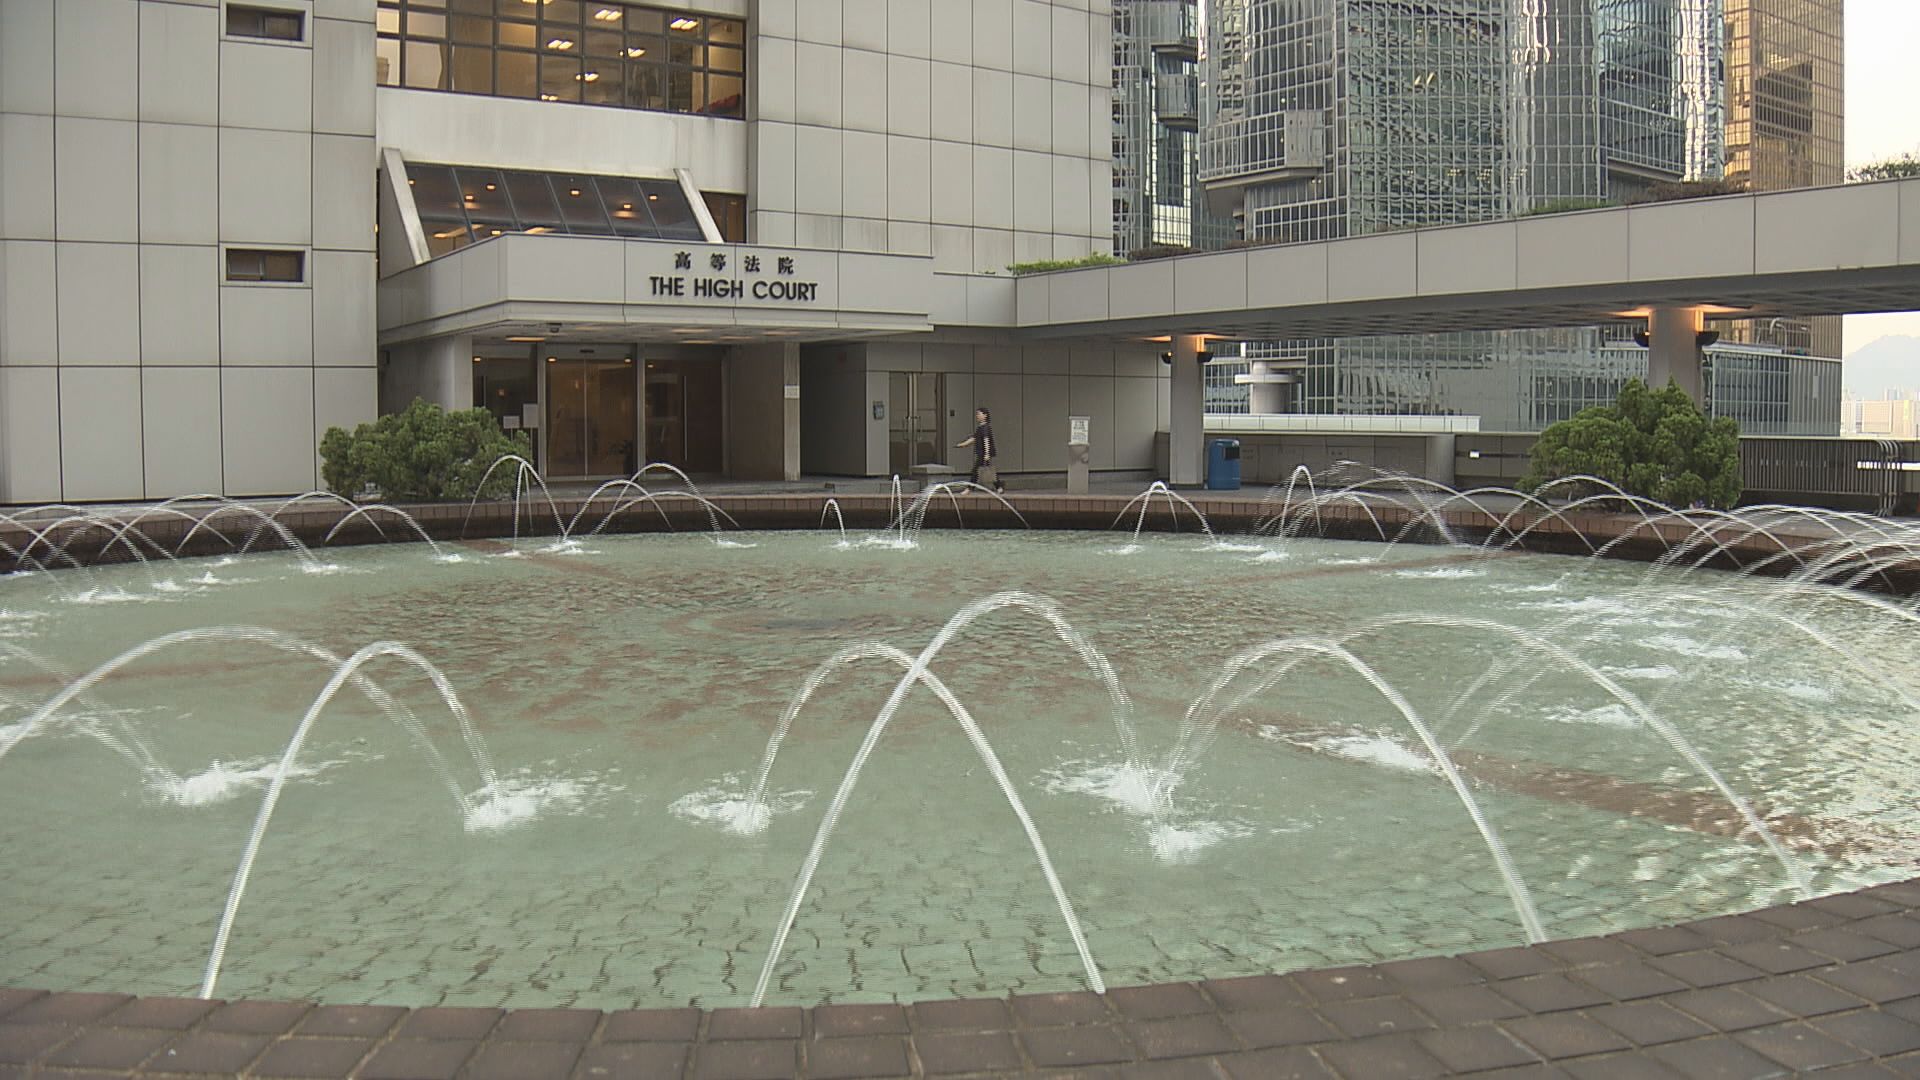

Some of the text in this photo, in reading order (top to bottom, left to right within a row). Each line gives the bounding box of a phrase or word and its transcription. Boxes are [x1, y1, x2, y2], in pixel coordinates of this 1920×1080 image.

[674, 251, 795, 275] 高等法院
[649, 276, 818, 301] THE HIGH COURT
